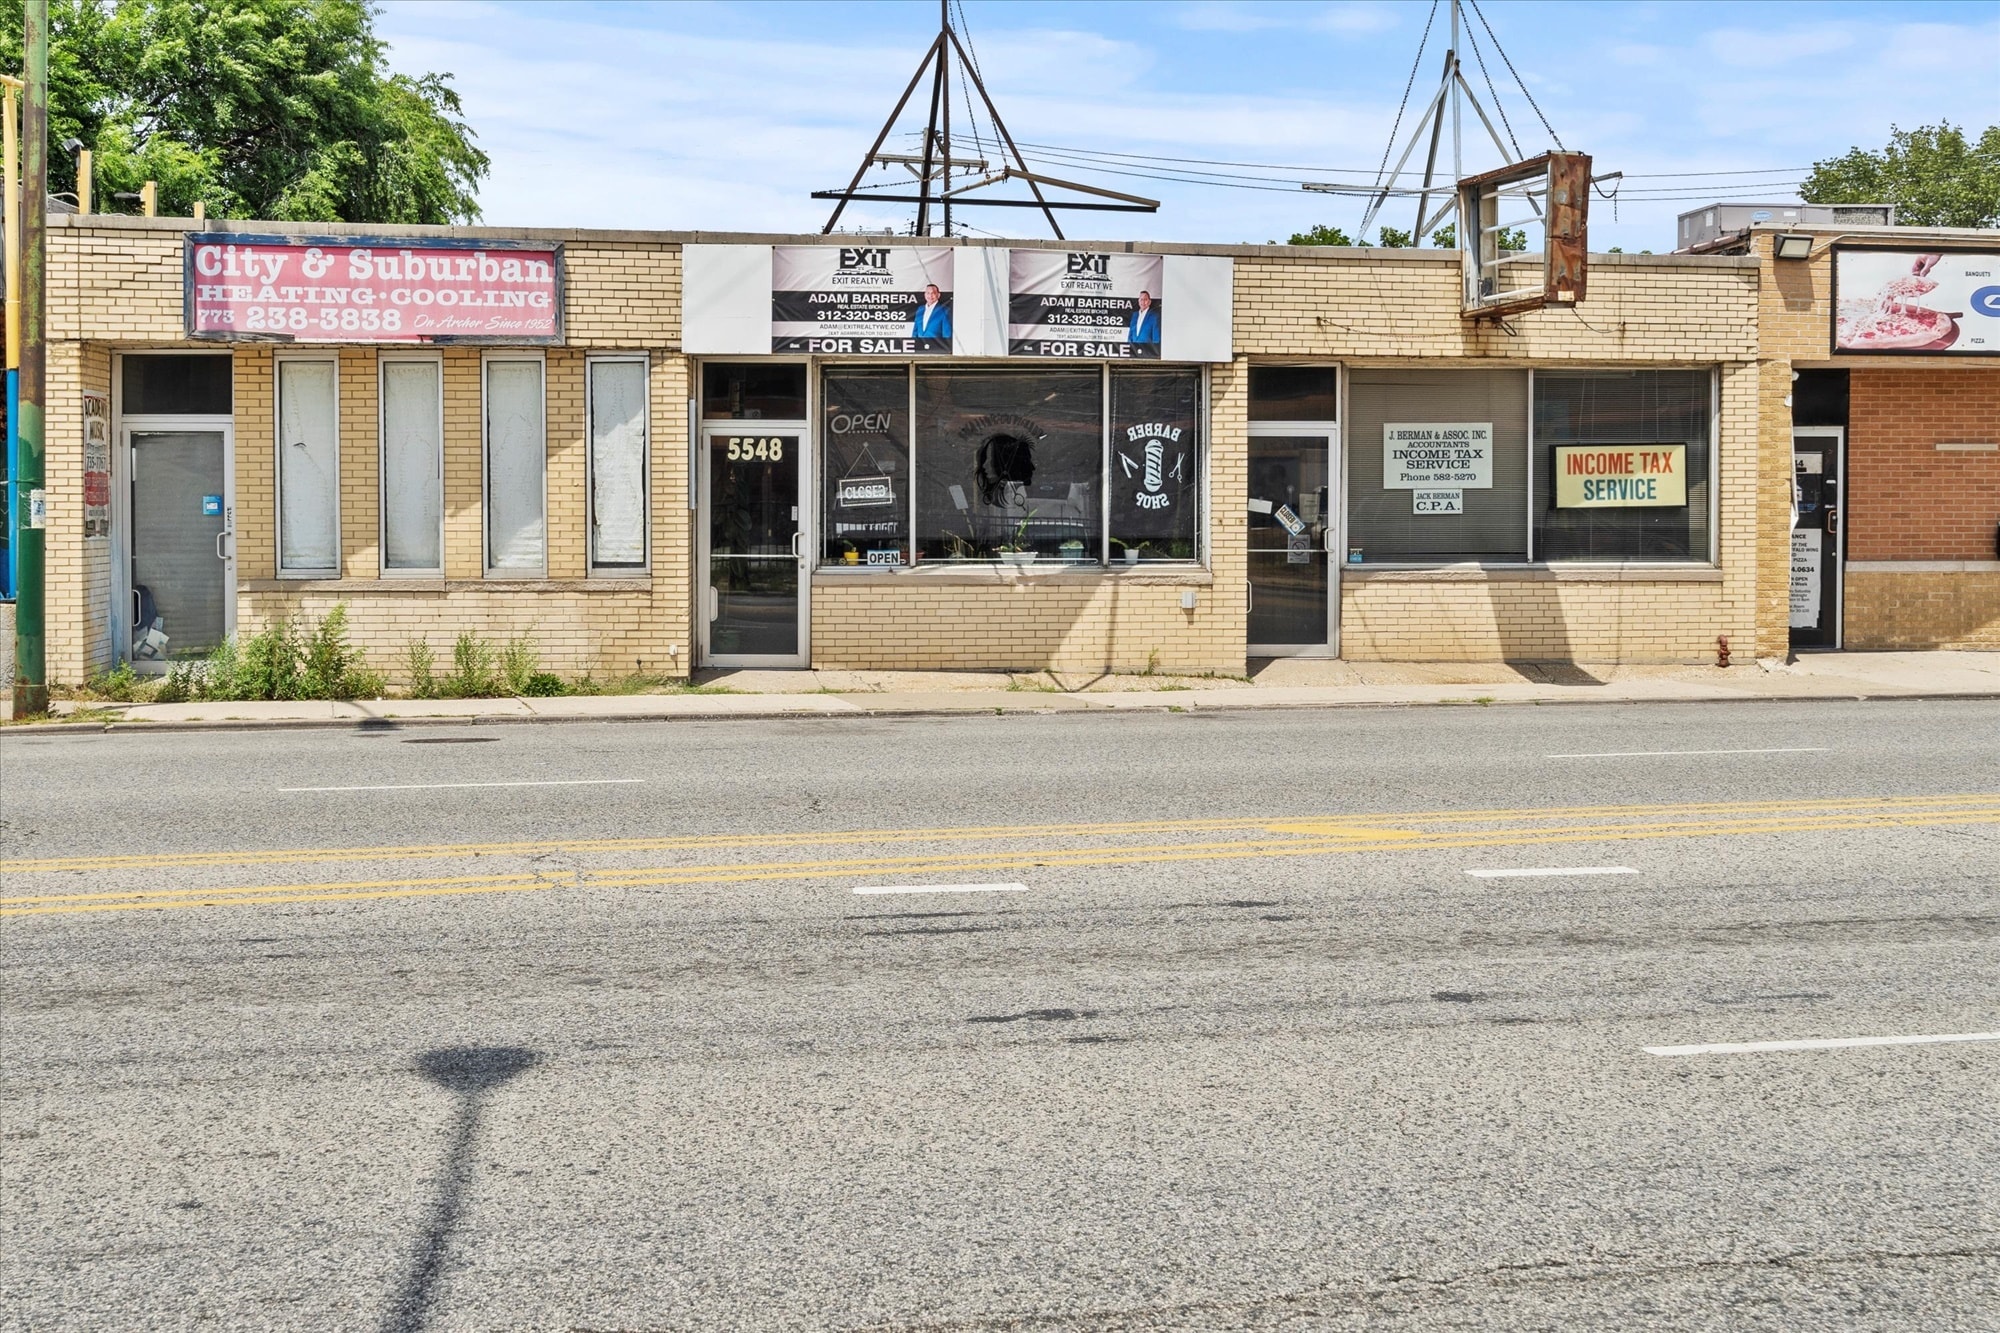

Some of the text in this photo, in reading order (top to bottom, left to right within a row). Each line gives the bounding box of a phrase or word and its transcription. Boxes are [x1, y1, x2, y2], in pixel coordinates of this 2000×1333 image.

[196, 245, 553, 284] City & Suburban
[832, 277, 894, 285] EXIT REALTY WE
[1061, 281, 1113, 291] EXIT REALTY WE
[197, 285, 553, 308] HEATING COOLING
[808, 294, 918, 304] ADAM BARRERA
[1040, 297, 1133, 310] ADAM BARRERA
[200, 306, 402, 331] 773 238-3838
[817, 310, 907, 321] 312-320-8362
[1047, 314, 1124, 326] 312-320-8362
[414, 315, 552, 330] On Archer Since 1952
[808, 339, 853, 353] FOR
[859, 340, 916, 353] SALE
[1040, 342, 1078, 356] FOR
[1083, 344, 1131, 357] SALE
[831, 413, 892, 434] OPEN
[1389, 430, 1487, 440] J. BERMAN & ASSOC. INC.
[727, 437, 782, 461] 5548
[1392, 449, 1484, 460] INCOME TAX
[1406, 460, 1470, 470] SERVICE
[1567, 451, 1673, 475] INCOME TAX
[1400, 473, 1477, 481] Phone 582-5270
[1583, 478, 1657, 501] SERVICE
[1416, 501, 1460, 511] C.P.A.
[869, 553, 899, 564] OPEN
